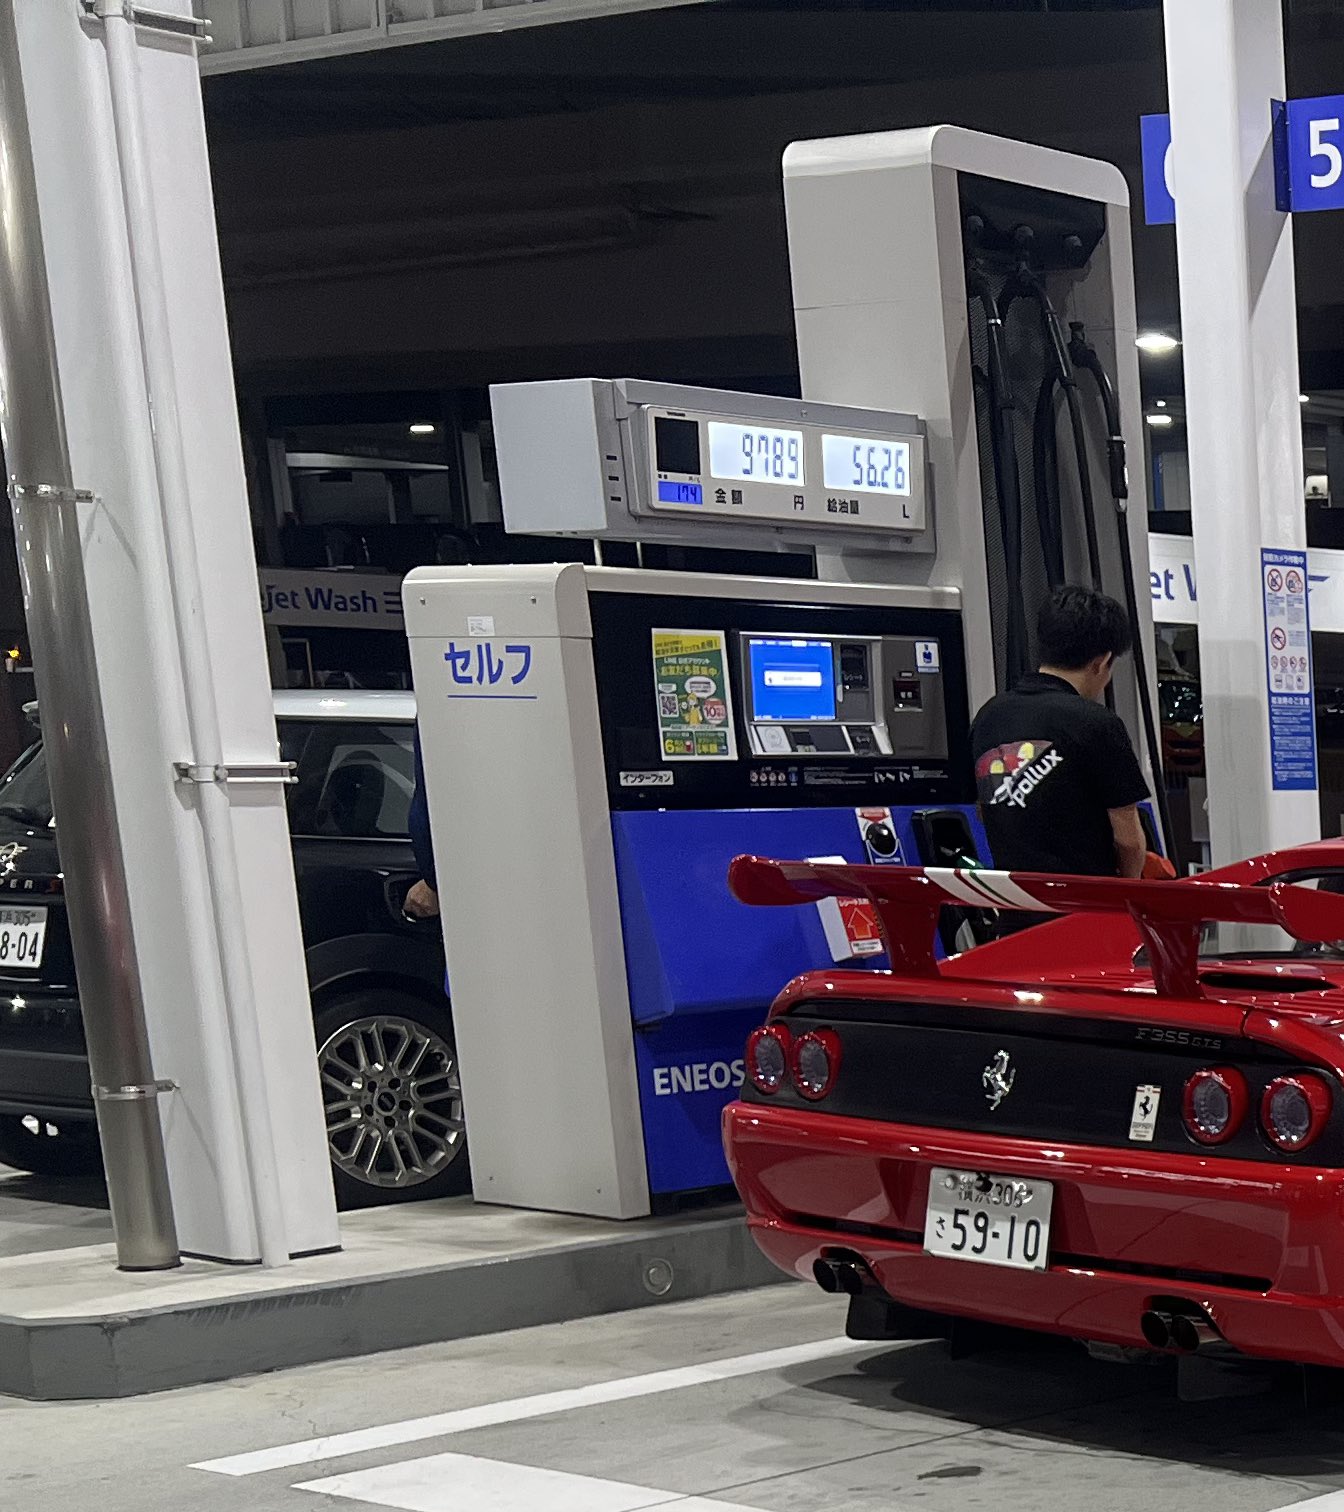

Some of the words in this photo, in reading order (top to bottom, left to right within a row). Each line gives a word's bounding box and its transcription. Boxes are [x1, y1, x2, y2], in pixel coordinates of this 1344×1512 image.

[1309, 118, 1343, 189] 5
[742, 432, 799, 480] 9789
[793, 495, 804, 511] 円
[827, 497, 860, 515] 給油量
[902, 504, 911, 519] L
[304, 587, 378, 614] Wash
[444, 642, 532, 685] セルフ
[1012, 749, 1063, 808] pollux
[1135, 1027, 1191, 1046] F355
[653, 1059, 746, 1096] ENEOS
[950, 1208, 1041, 1262] 59-10
